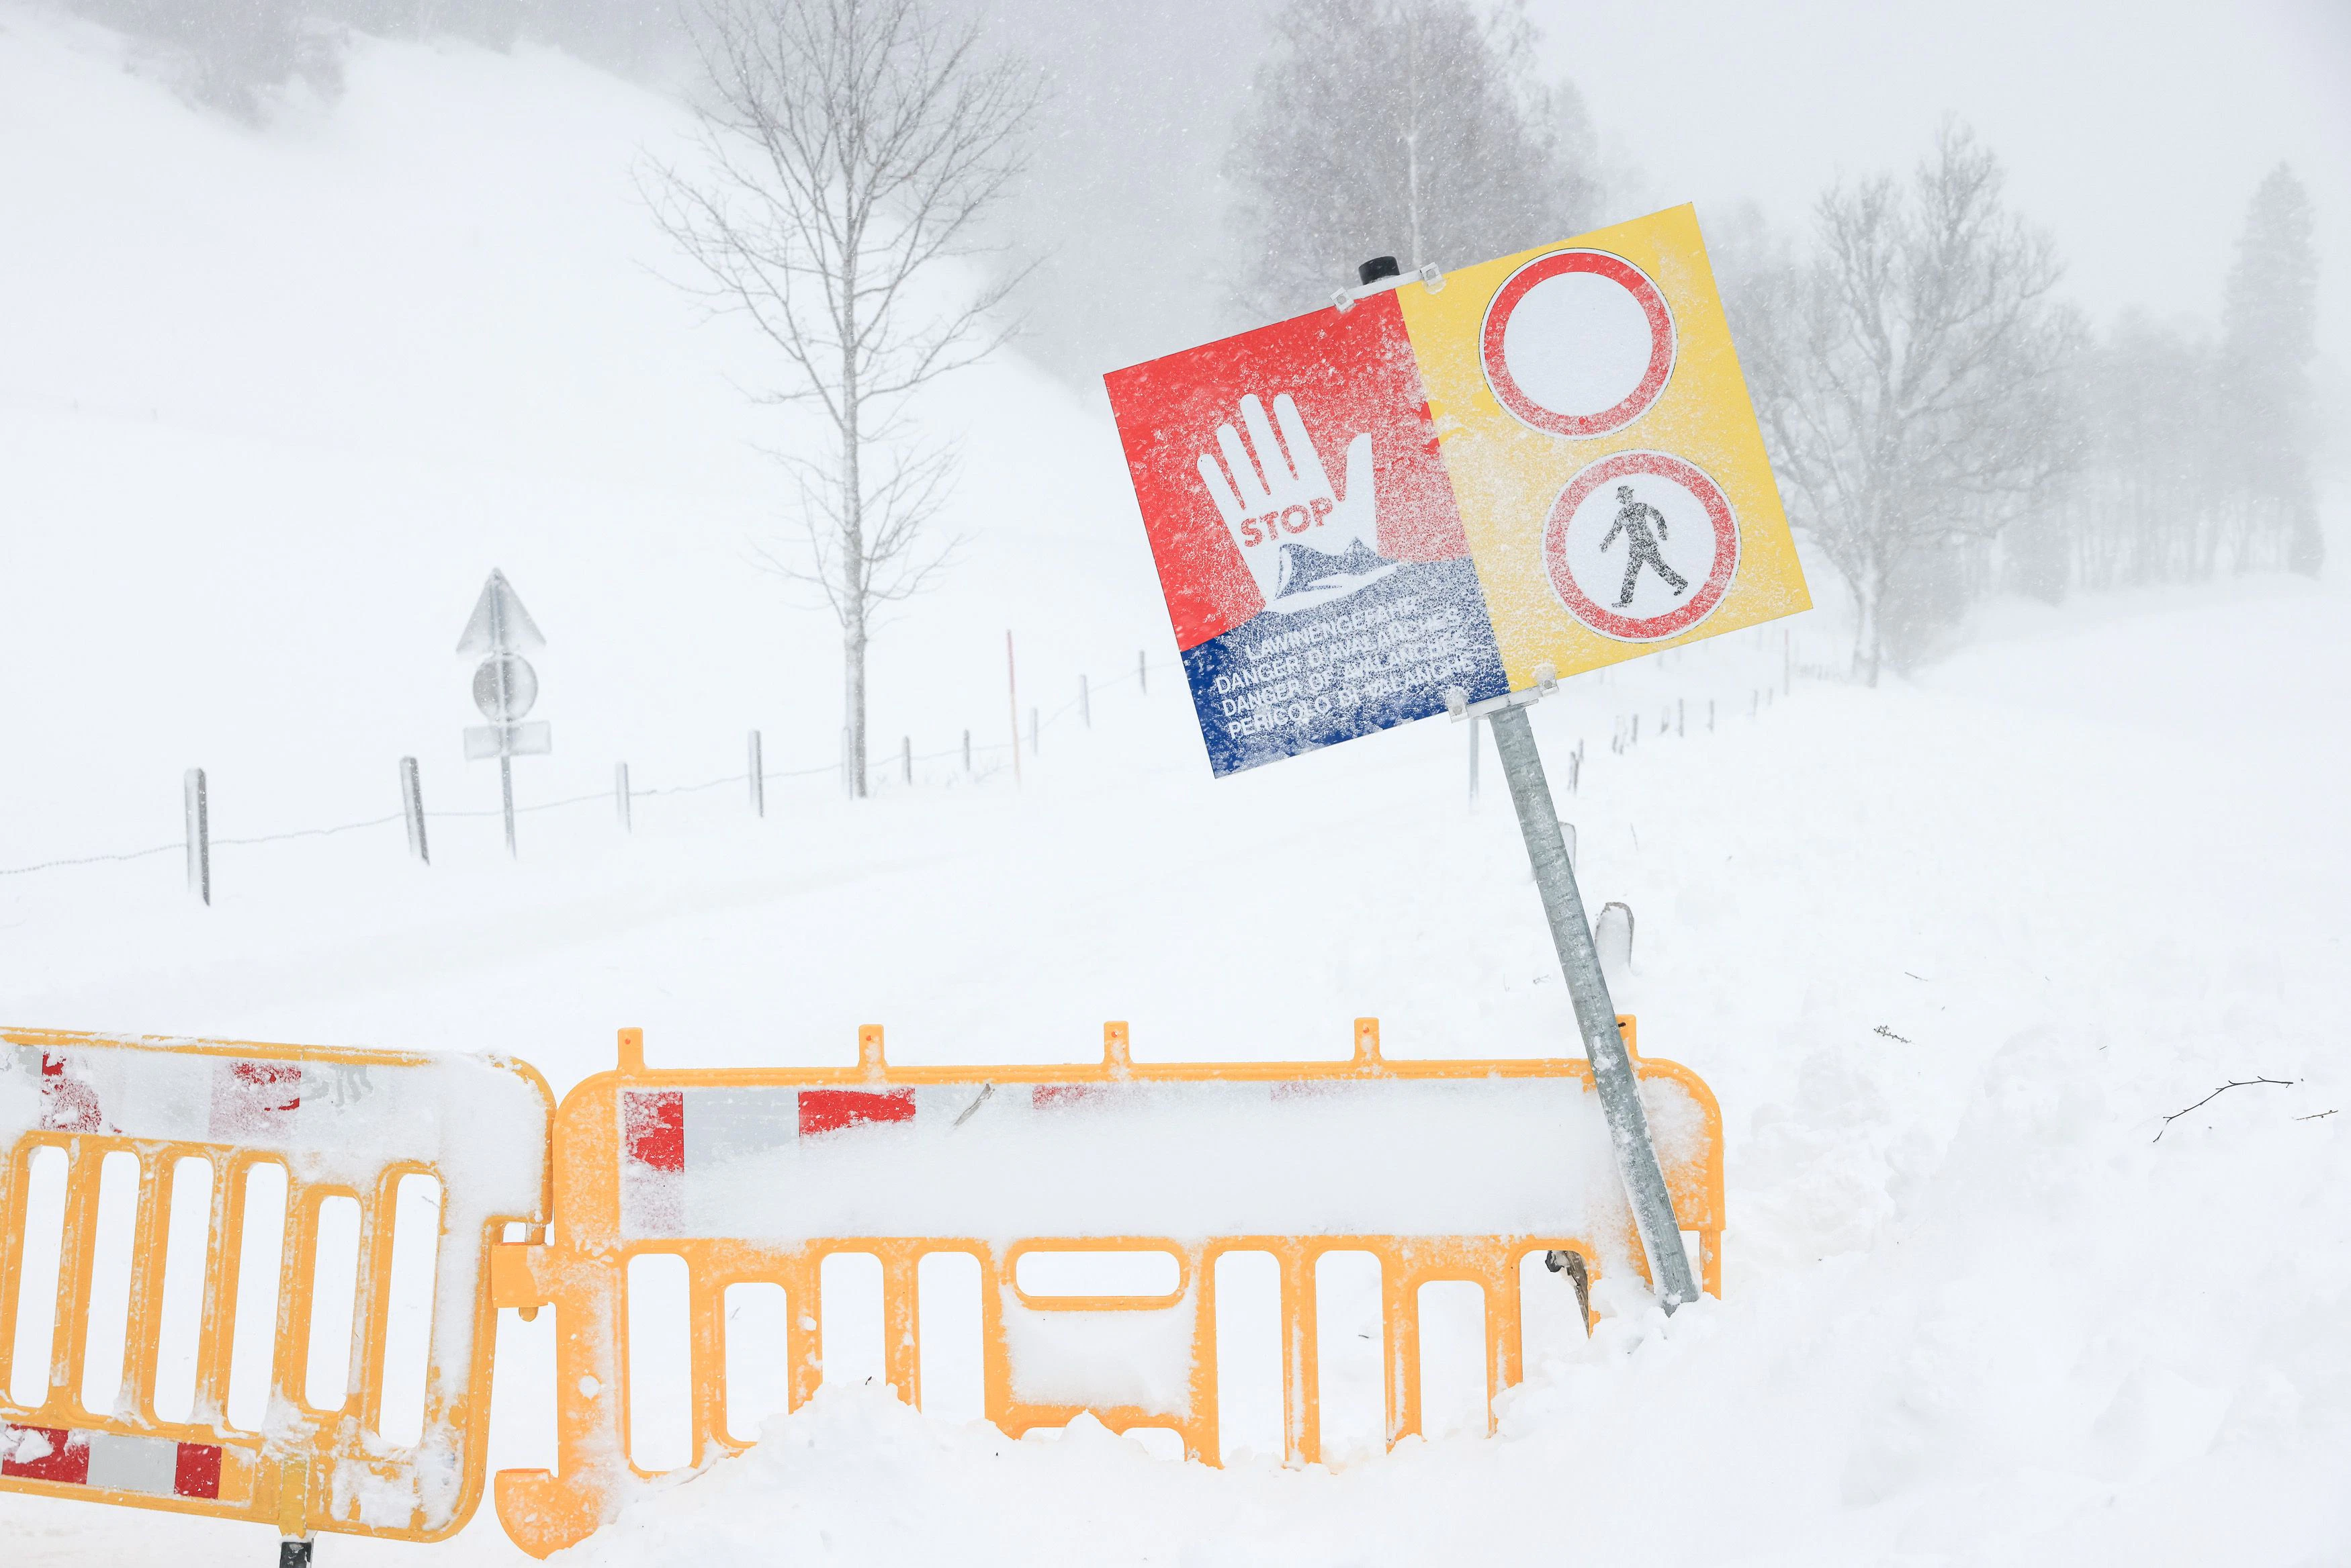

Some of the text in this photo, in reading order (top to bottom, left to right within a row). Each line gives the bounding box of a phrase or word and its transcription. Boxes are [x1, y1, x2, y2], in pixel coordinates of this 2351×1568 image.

[1241, 497, 1333, 547] STOP
[1215, 655, 1301, 694] DANGER
[1222, 678, 1307, 717] DANGER
[1308, 669, 1335, 692] OF
[1228, 694, 1331, 739] PERICOLO
